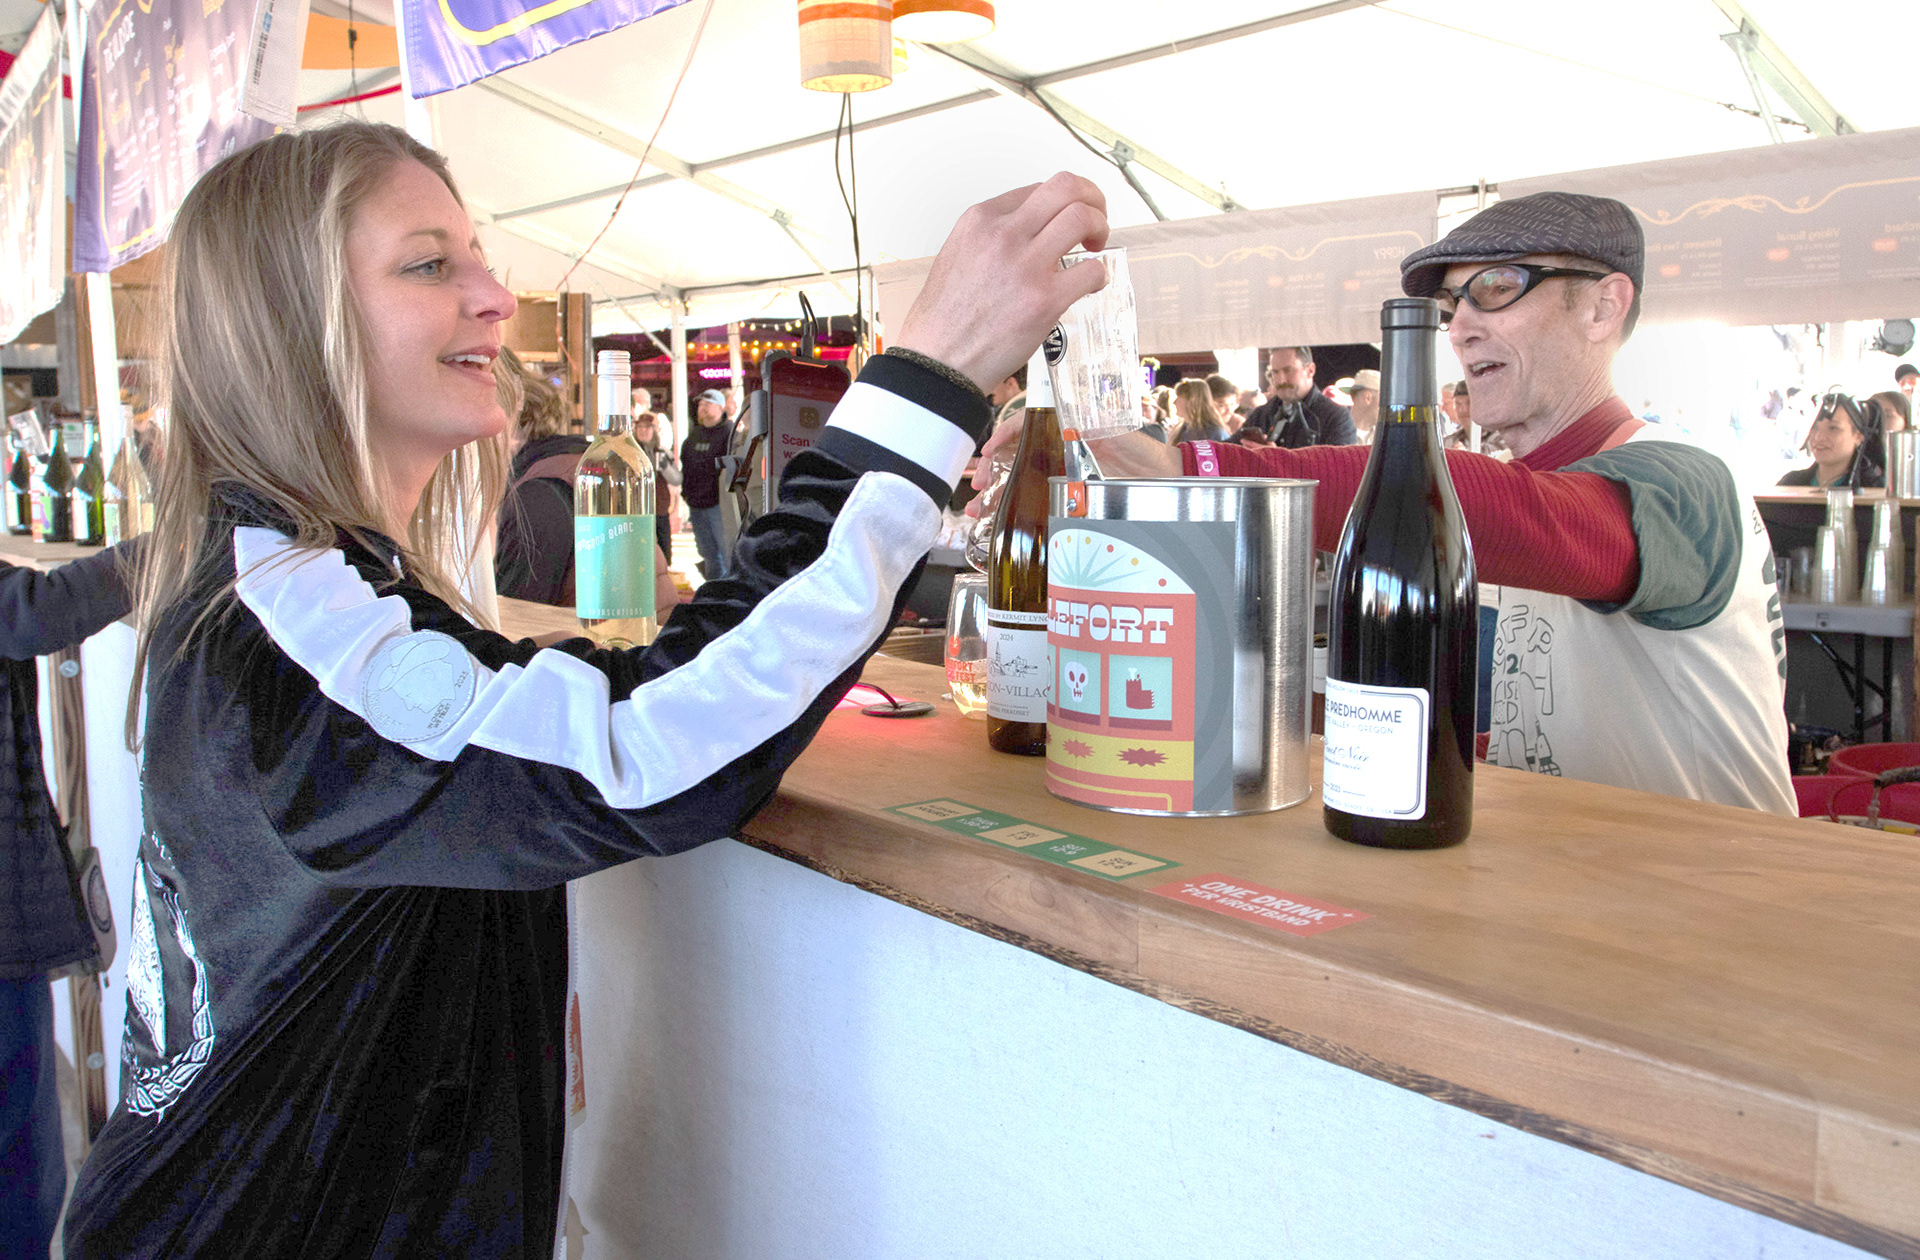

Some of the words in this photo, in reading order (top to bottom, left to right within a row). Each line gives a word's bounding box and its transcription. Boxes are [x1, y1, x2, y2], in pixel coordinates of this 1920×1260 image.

[782, 434, 810, 447] Scan
[608, 522, 634, 540] BLANC
[1002, 613, 1027, 622] KERMIT
[999, 633, 1014, 642] 2024
[454, 671, 469, 689] 2025
[1330, 700, 1403, 724] PREDHOMME
[1358, 724, 1394, 735] OREGON
[1338, 746, 1370, 762] Noir
[1181, 887, 1218, 900] PER
[1217, 897, 1313, 926] WRISTBAND
[1200, 880, 1259, 898] ONE
[1250, 895, 1338, 921] DRINK
